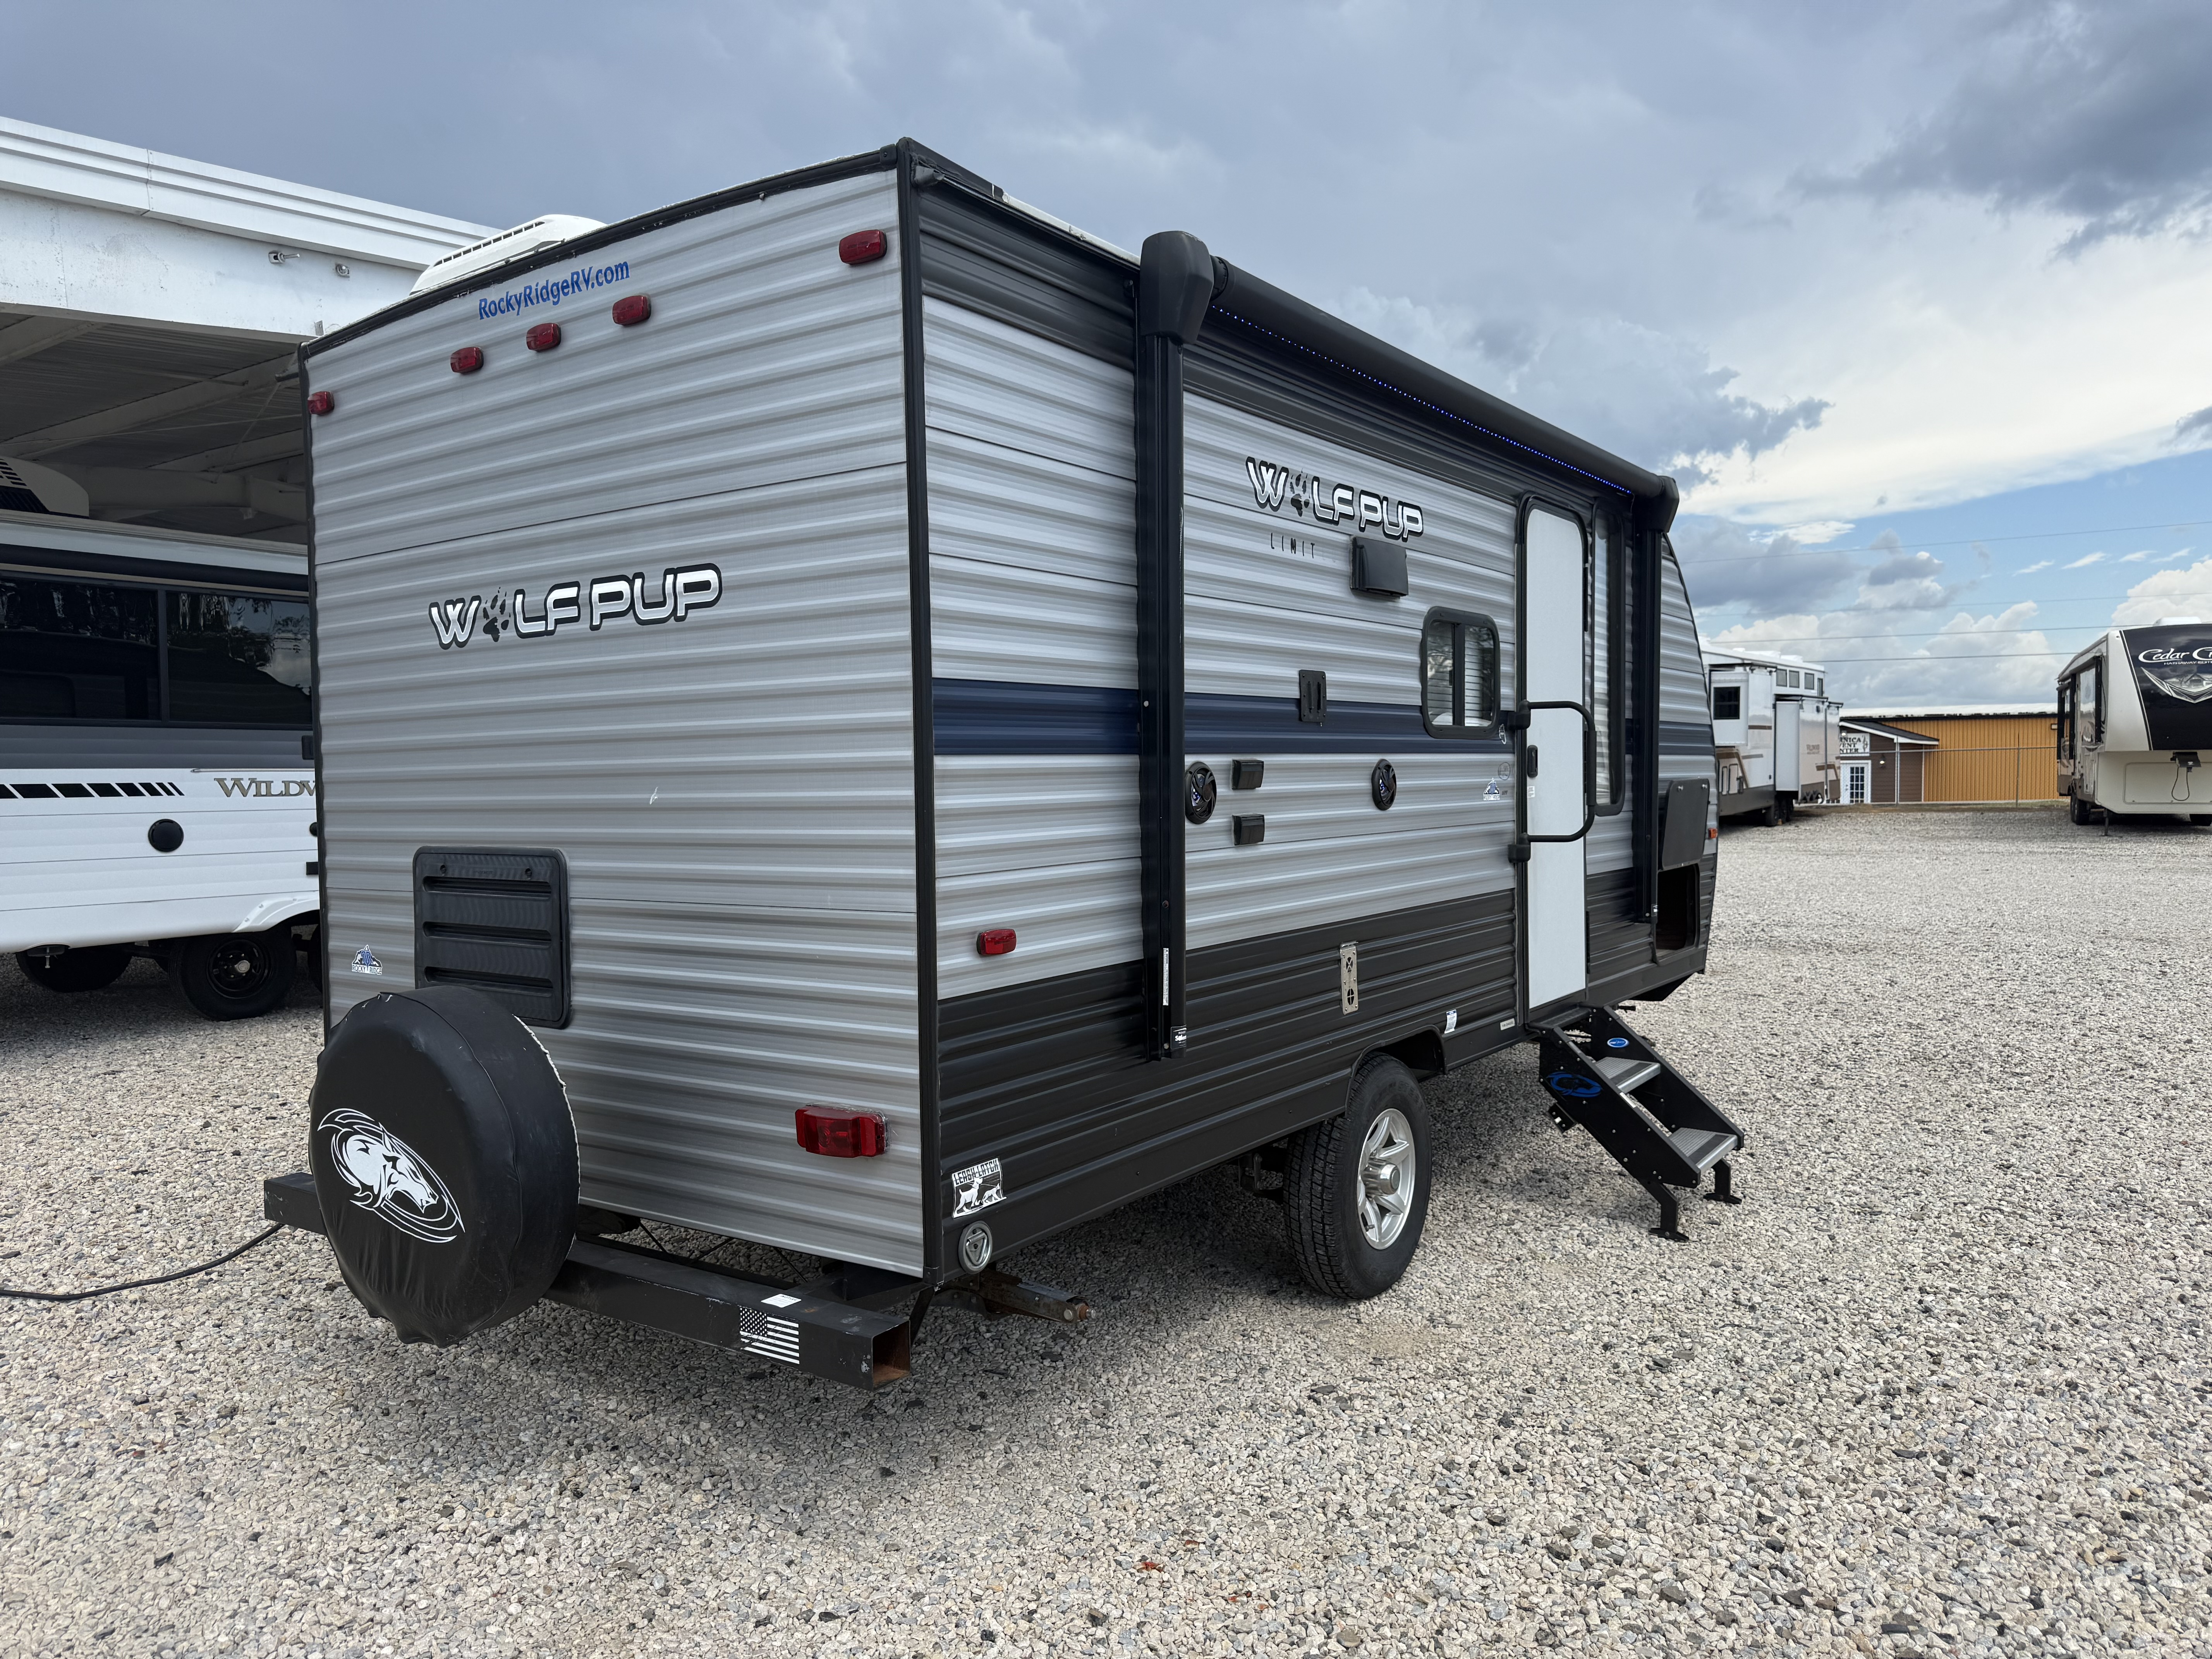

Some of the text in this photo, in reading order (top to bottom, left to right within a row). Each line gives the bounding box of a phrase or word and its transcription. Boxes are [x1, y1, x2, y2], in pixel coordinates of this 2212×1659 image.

[479, 261, 630, 320] RockyRidgeRV.com
[1358, 489, 1424, 543] PUP
[589, 563, 723, 631] PUP
[2138, 648, 2190, 663] Cedar
[352, 965, 366, 973] ROCKY
